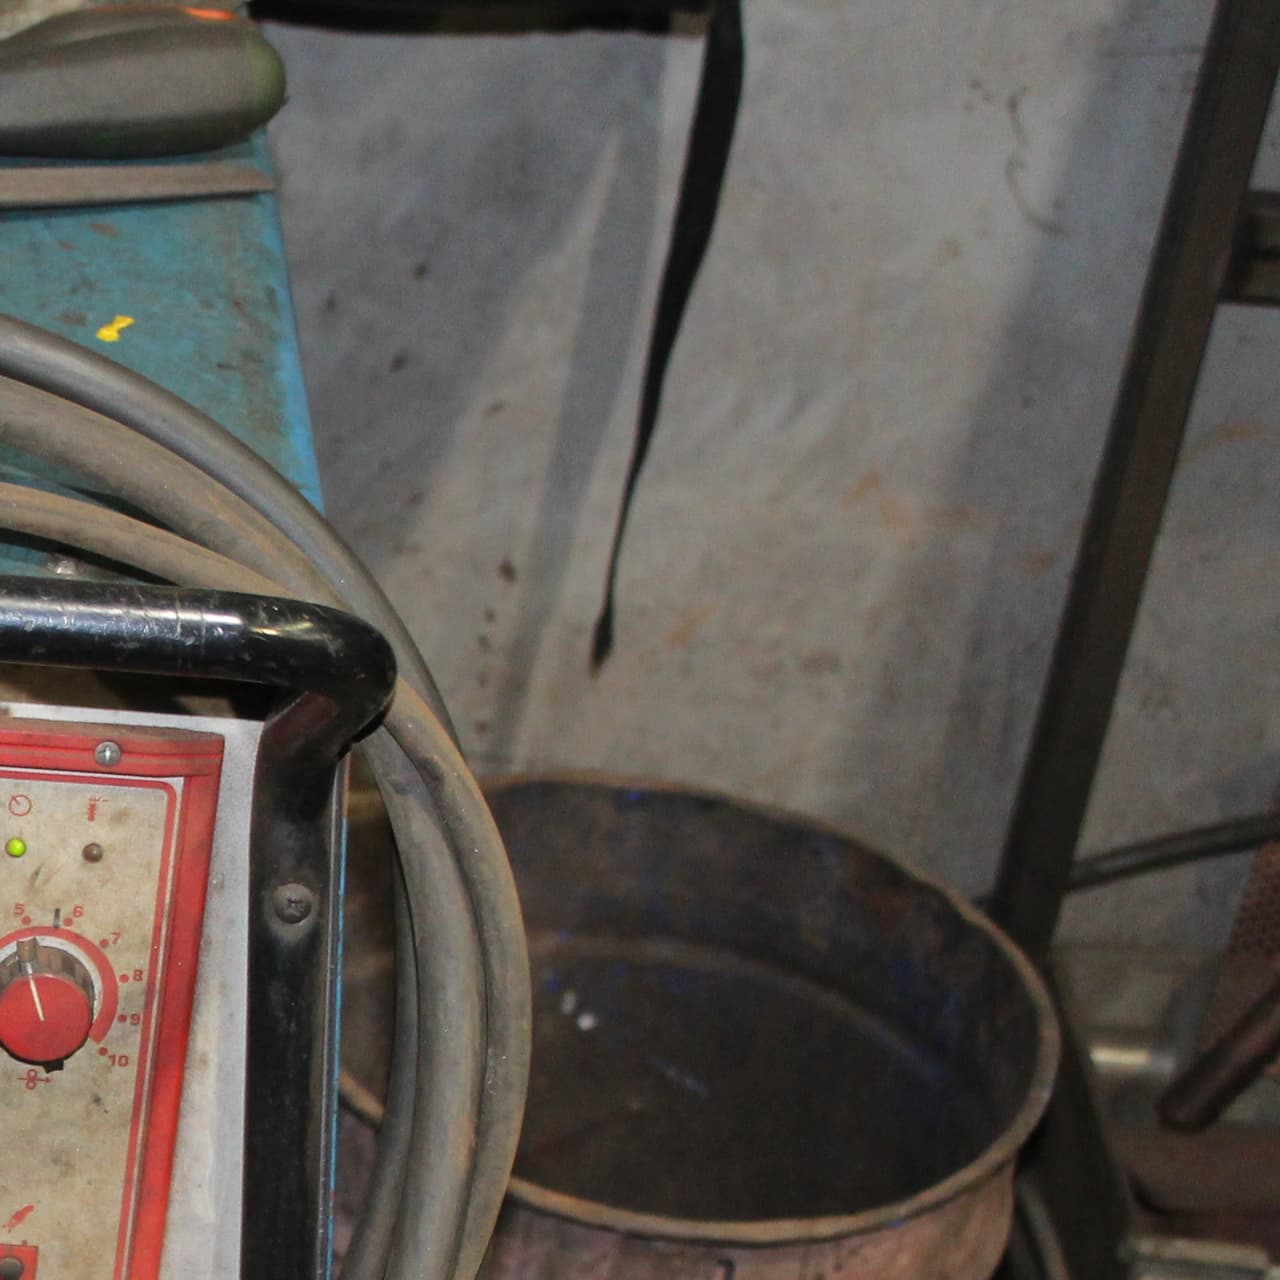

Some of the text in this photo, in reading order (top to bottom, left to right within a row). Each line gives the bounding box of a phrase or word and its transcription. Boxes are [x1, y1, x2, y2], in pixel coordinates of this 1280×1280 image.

[14, 903, 25, 916] 5
[73, 905, 84, 918] 6
[111, 932, 121, 945] 7
[133, 969, 143, 982] 8
[130, 1013, 141, 1026] 9
[109, 1055, 129, 1067] 10
